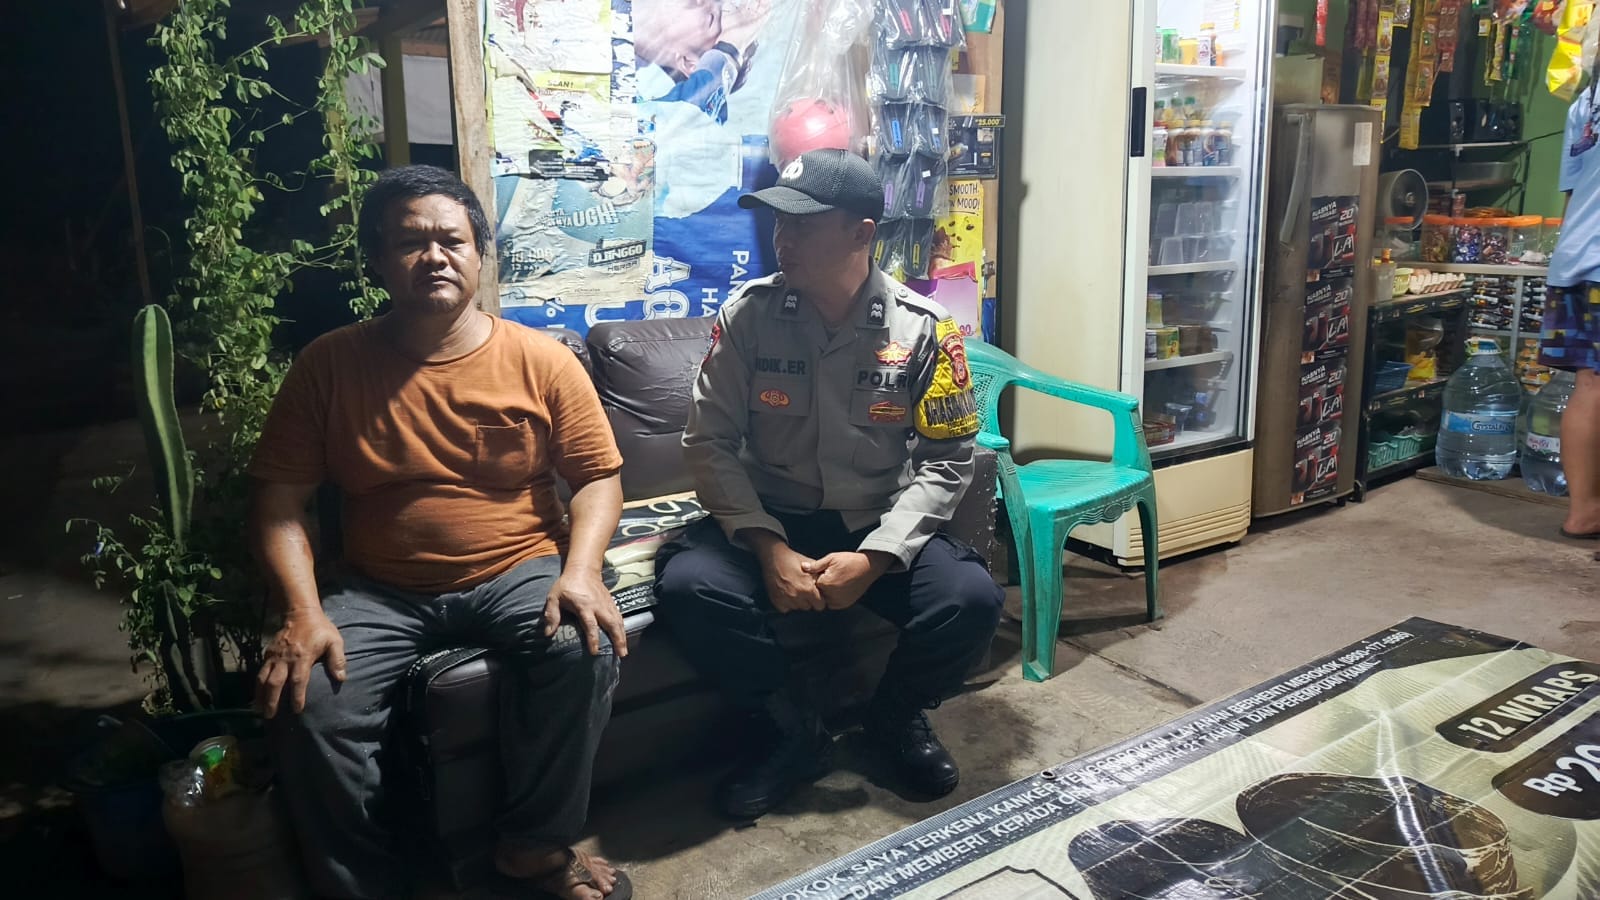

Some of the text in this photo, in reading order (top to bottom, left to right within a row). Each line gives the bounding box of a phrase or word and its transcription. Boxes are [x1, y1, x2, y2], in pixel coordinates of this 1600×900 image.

[849, 872, 897, 900] DAN
[895, 833, 988, 880] MEMBERI
[988, 802, 1062, 837] KEPADA
[1199, 719, 1250, 743] TAHUN
[1247, 704, 1279, 723] DAN
[1272, 672, 1347, 711] PEREMPUAN
[851, 848, 908, 874] SAYA
[903, 811, 993, 851] TERKENA
[988, 782, 1061, 816] KANKER
[1169, 709, 1234, 740] LAYANAN
[1227, 684, 1288, 714] BERHENTI
[1284, 660, 1345, 691] MEROKOK
[1457, 670, 1600, 740] 12 WRAPS
